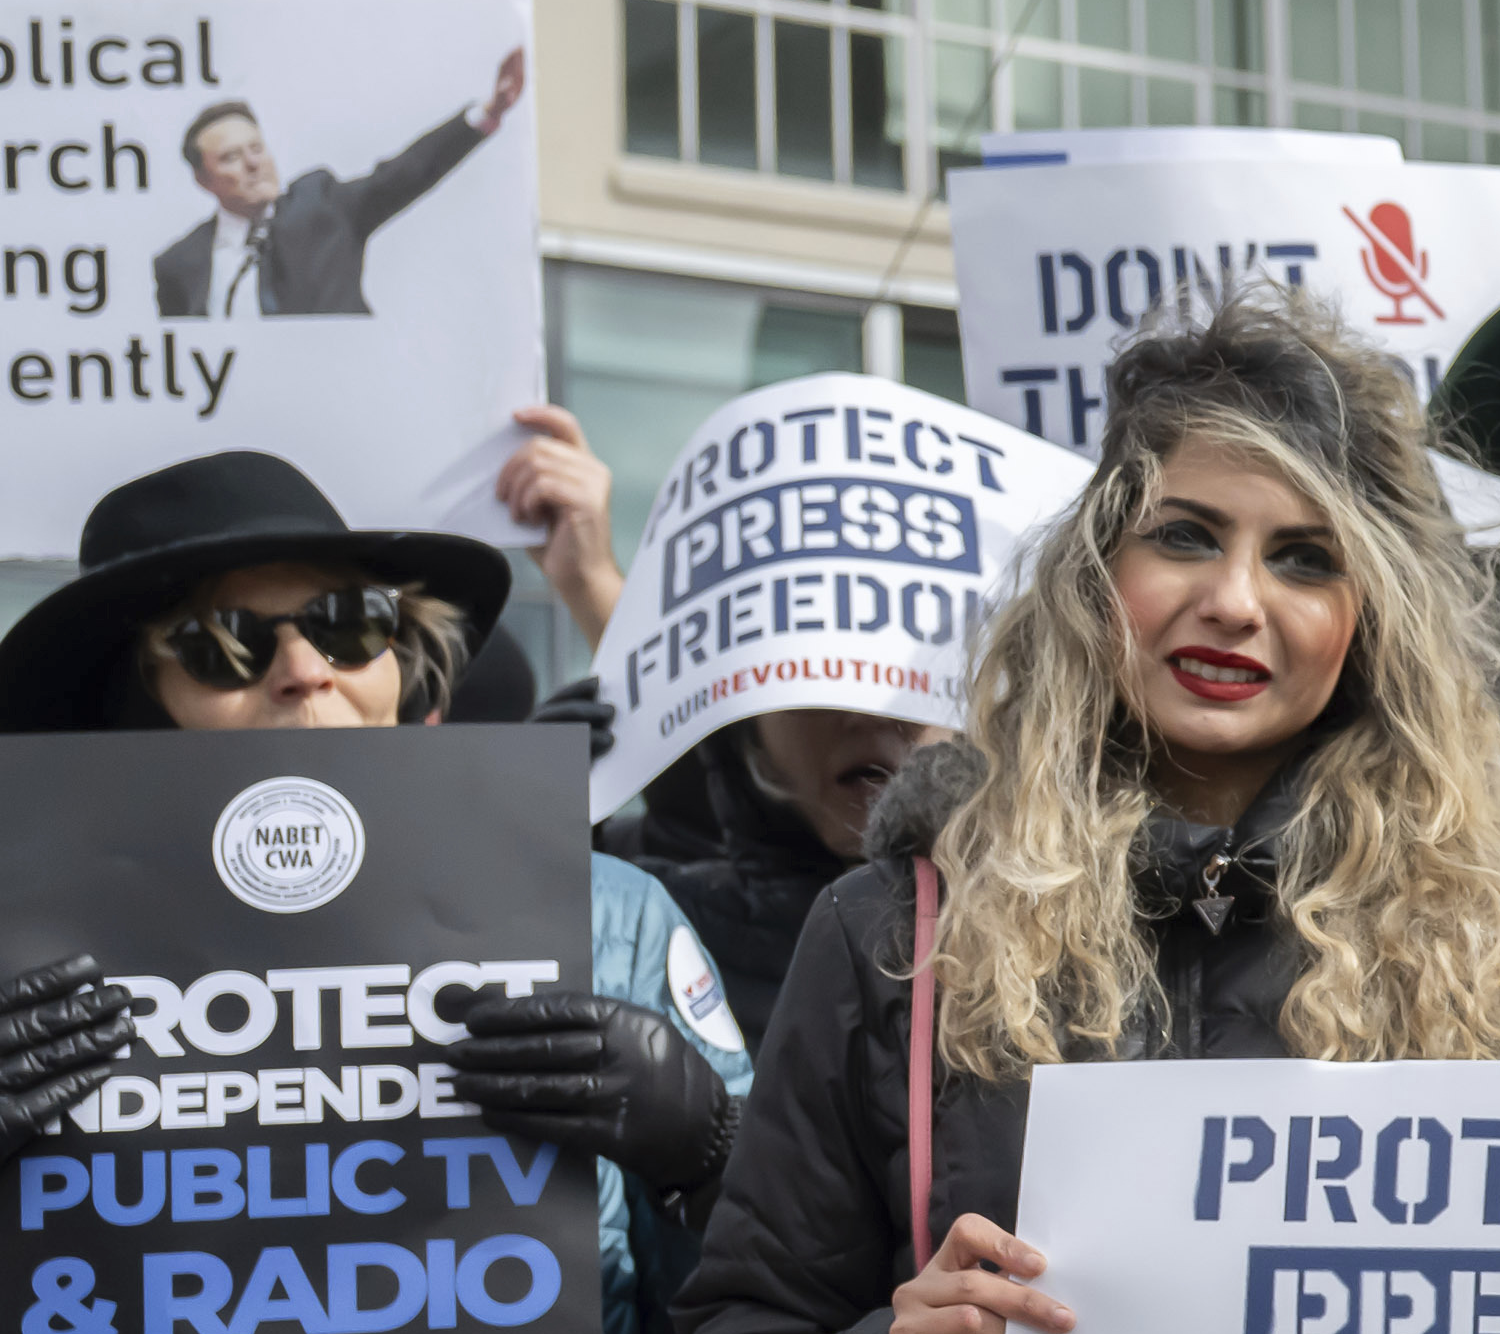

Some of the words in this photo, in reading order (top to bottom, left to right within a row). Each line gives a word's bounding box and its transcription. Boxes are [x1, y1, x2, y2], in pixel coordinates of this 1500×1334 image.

[4, 124, 149, 190] rch
[4, 246, 108, 312] ng
[9, 331, 235, 417] ently
[646, 407, 1007, 545] PROTECT
[672, 484, 967, 598] PRESS
[256, 824, 322, 847] NABET
[265, 850, 314, 870] CWA
[76, 959, 559, 1057] ROTECT
[20, 1140, 407, 1231] PUBLIC
[423, 1135, 562, 1210] TV
